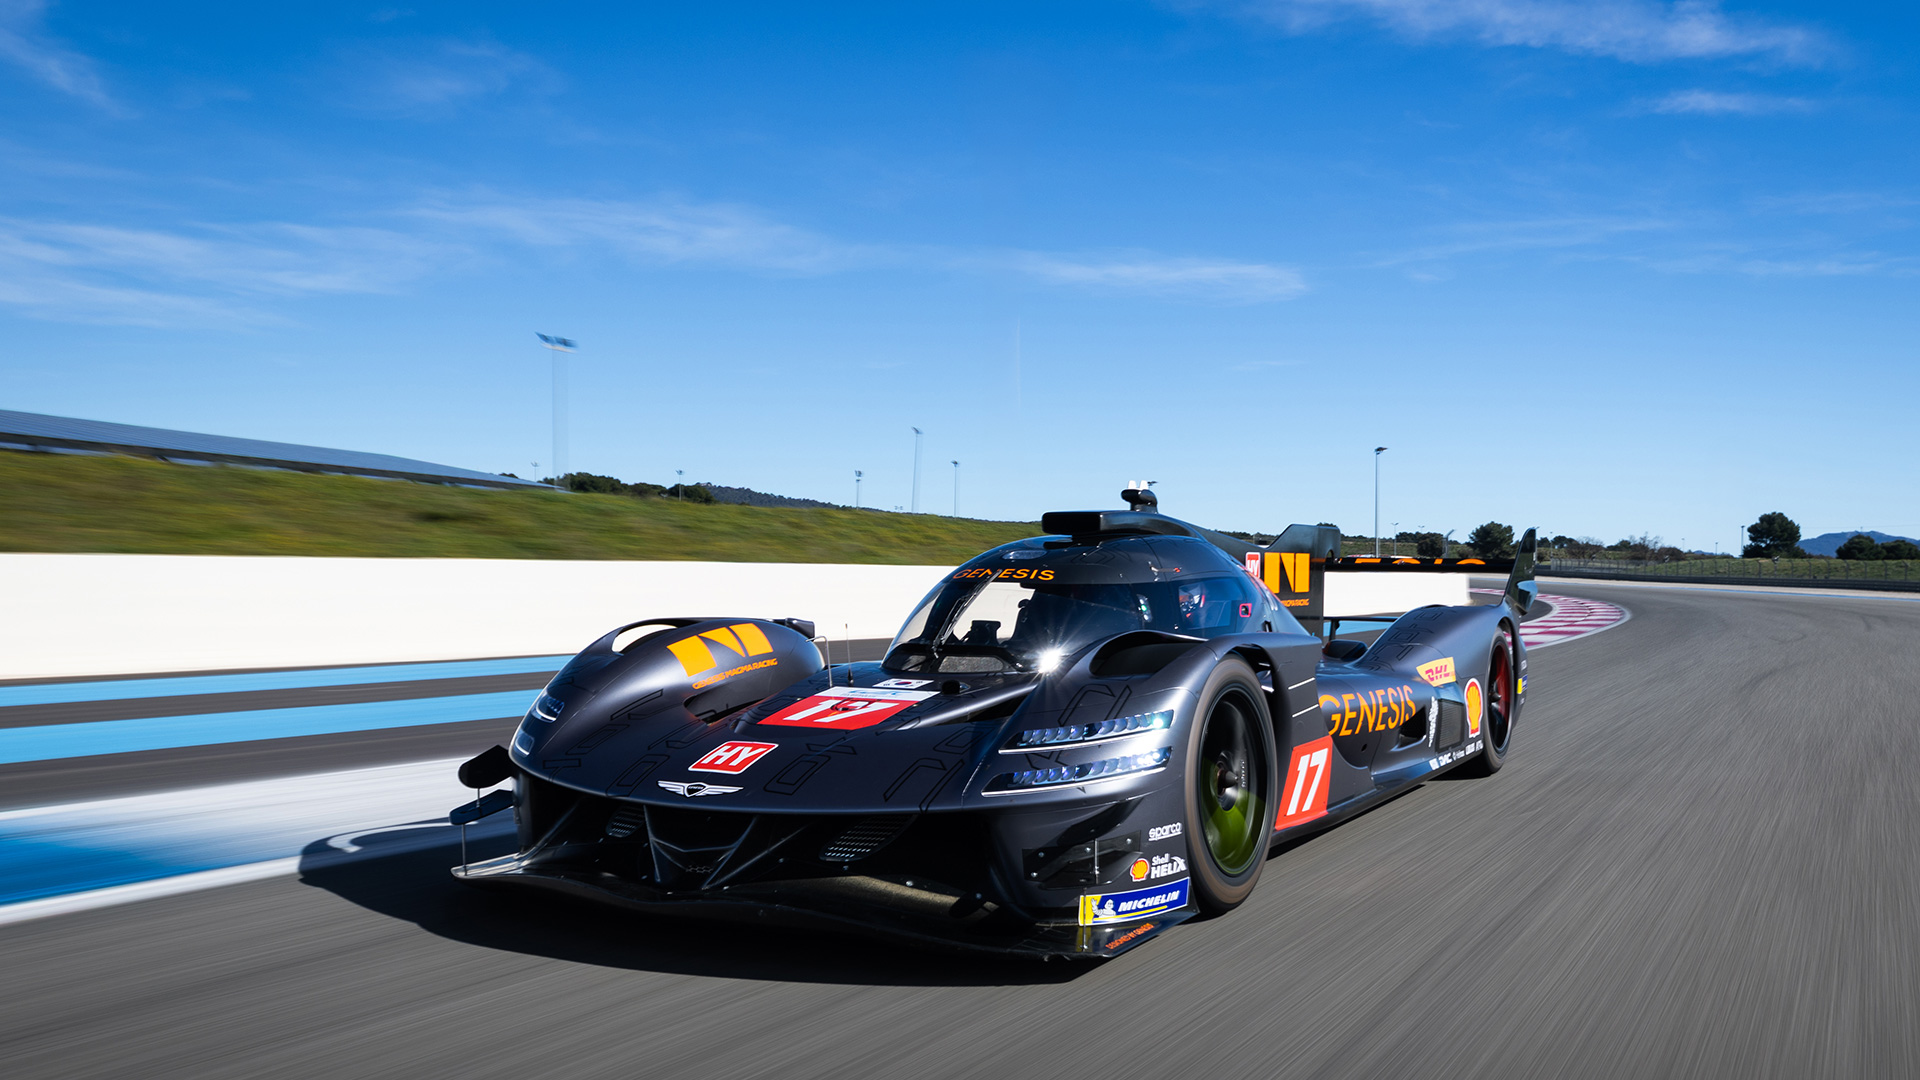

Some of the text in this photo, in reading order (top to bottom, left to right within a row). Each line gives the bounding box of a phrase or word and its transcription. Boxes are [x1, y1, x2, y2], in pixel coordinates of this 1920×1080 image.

[692, 658, 778, 690] GENESIS MAGMA RACING
[1425, 664, 1450, 682] DHL
[783, 699, 900, 723] 17
[1318, 685, 1416, 737] GENESIS
[700, 745, 768, 767] HY
[1286, 748, 1329, 816] 17
[1148, 822, 1182, 841] sparco
[1150, 857, 1187, 879] HELIX
[1151, 853, 1170, 866] Shell
[1118, 890, 1180, 912] MICHELIN
